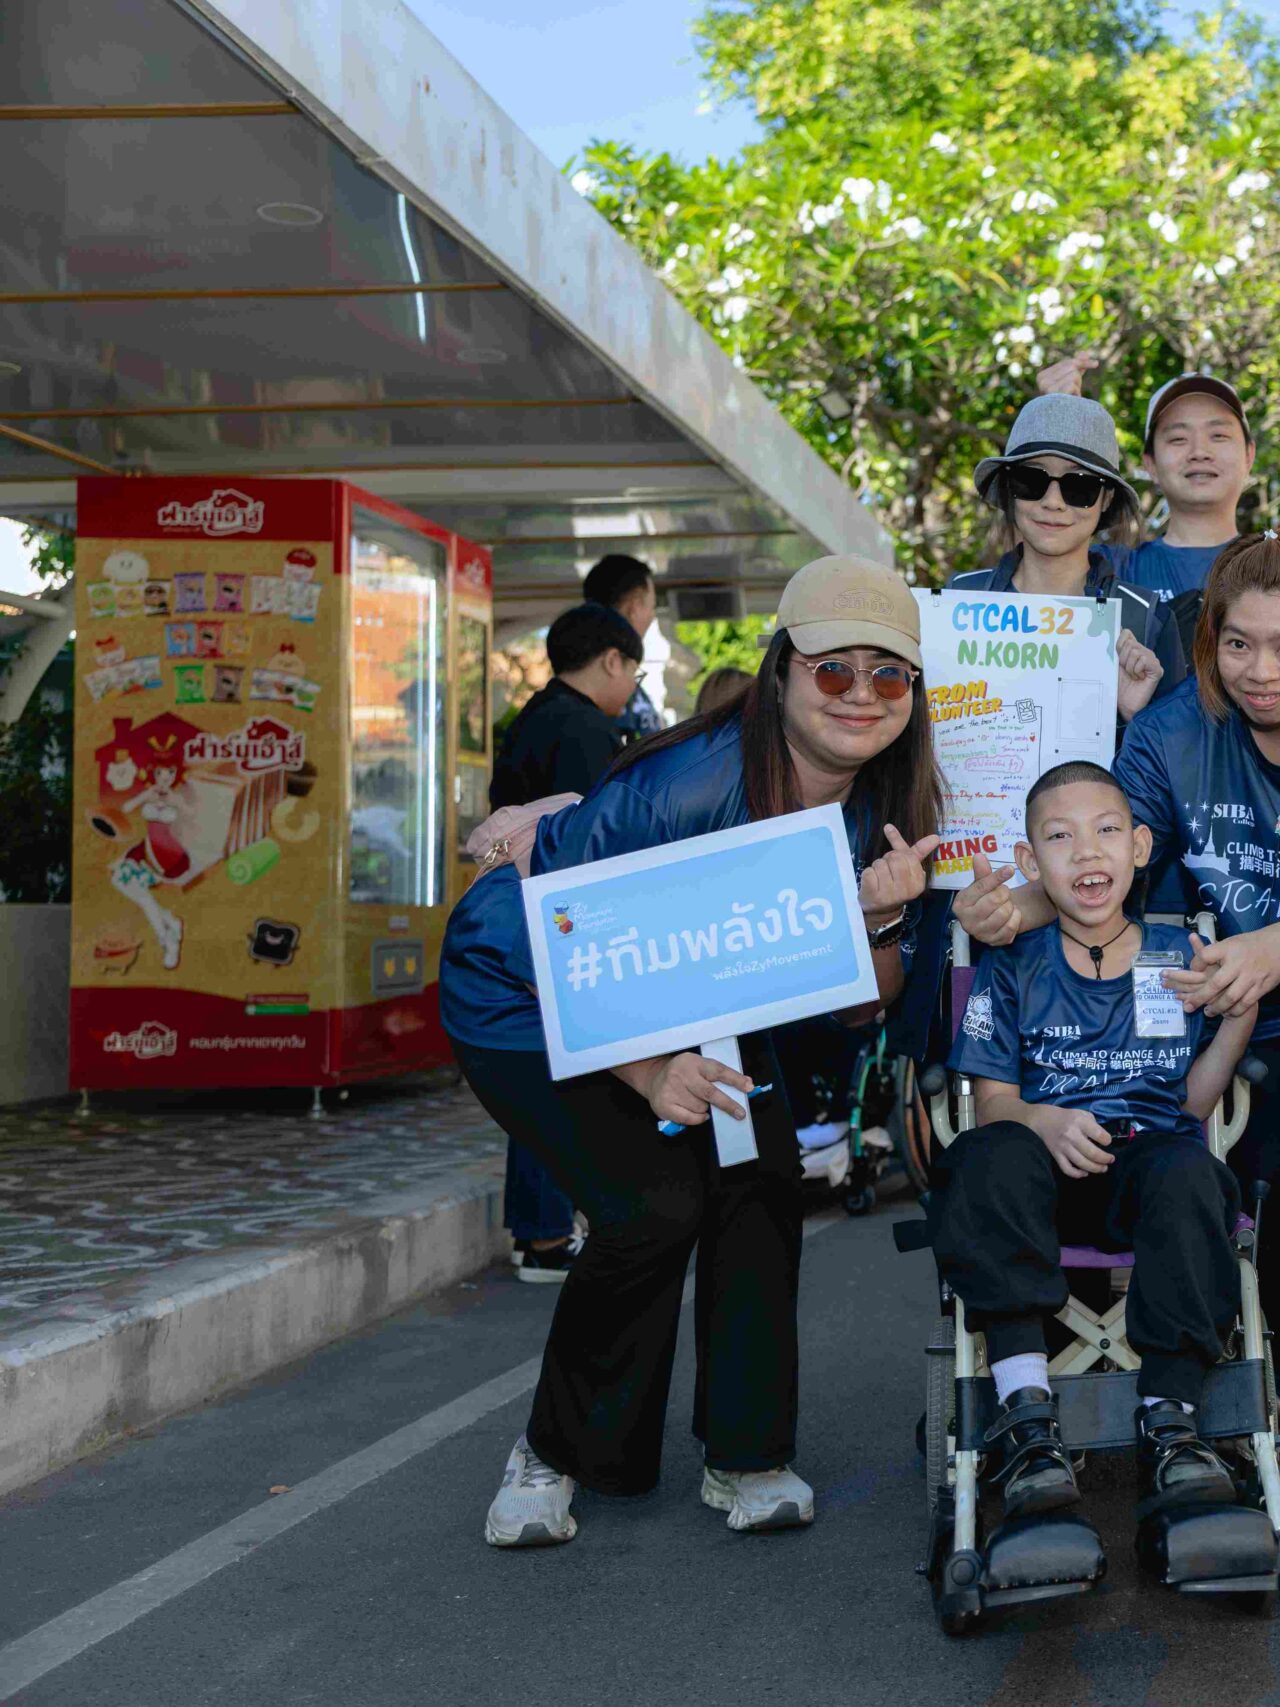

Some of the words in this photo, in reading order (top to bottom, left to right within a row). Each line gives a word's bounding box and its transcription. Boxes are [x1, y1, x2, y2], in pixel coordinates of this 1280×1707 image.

[951, 601, 1075, 636] CTCAL32
[957, 639, 1059, 669] N.KORN
[927, 680, 987, 705] FROM
[928, 697, 1003, 723] LUNTEER
[1212, 803, 1255, 820] SIBA
[1226, 841, 1264, 860] CLIMB
[566, 888, 834, 992] #ทีมพลังใจ
[1042, 1025, 1081, 1037] SIBA
[1092, 1050, 1107, 1059] TO
[1110, 1050, 1153, 1060] CHANGE
[1158, 1049, 1168, 1058] A
[1170, 1047, 1191, 1057] LIFE
